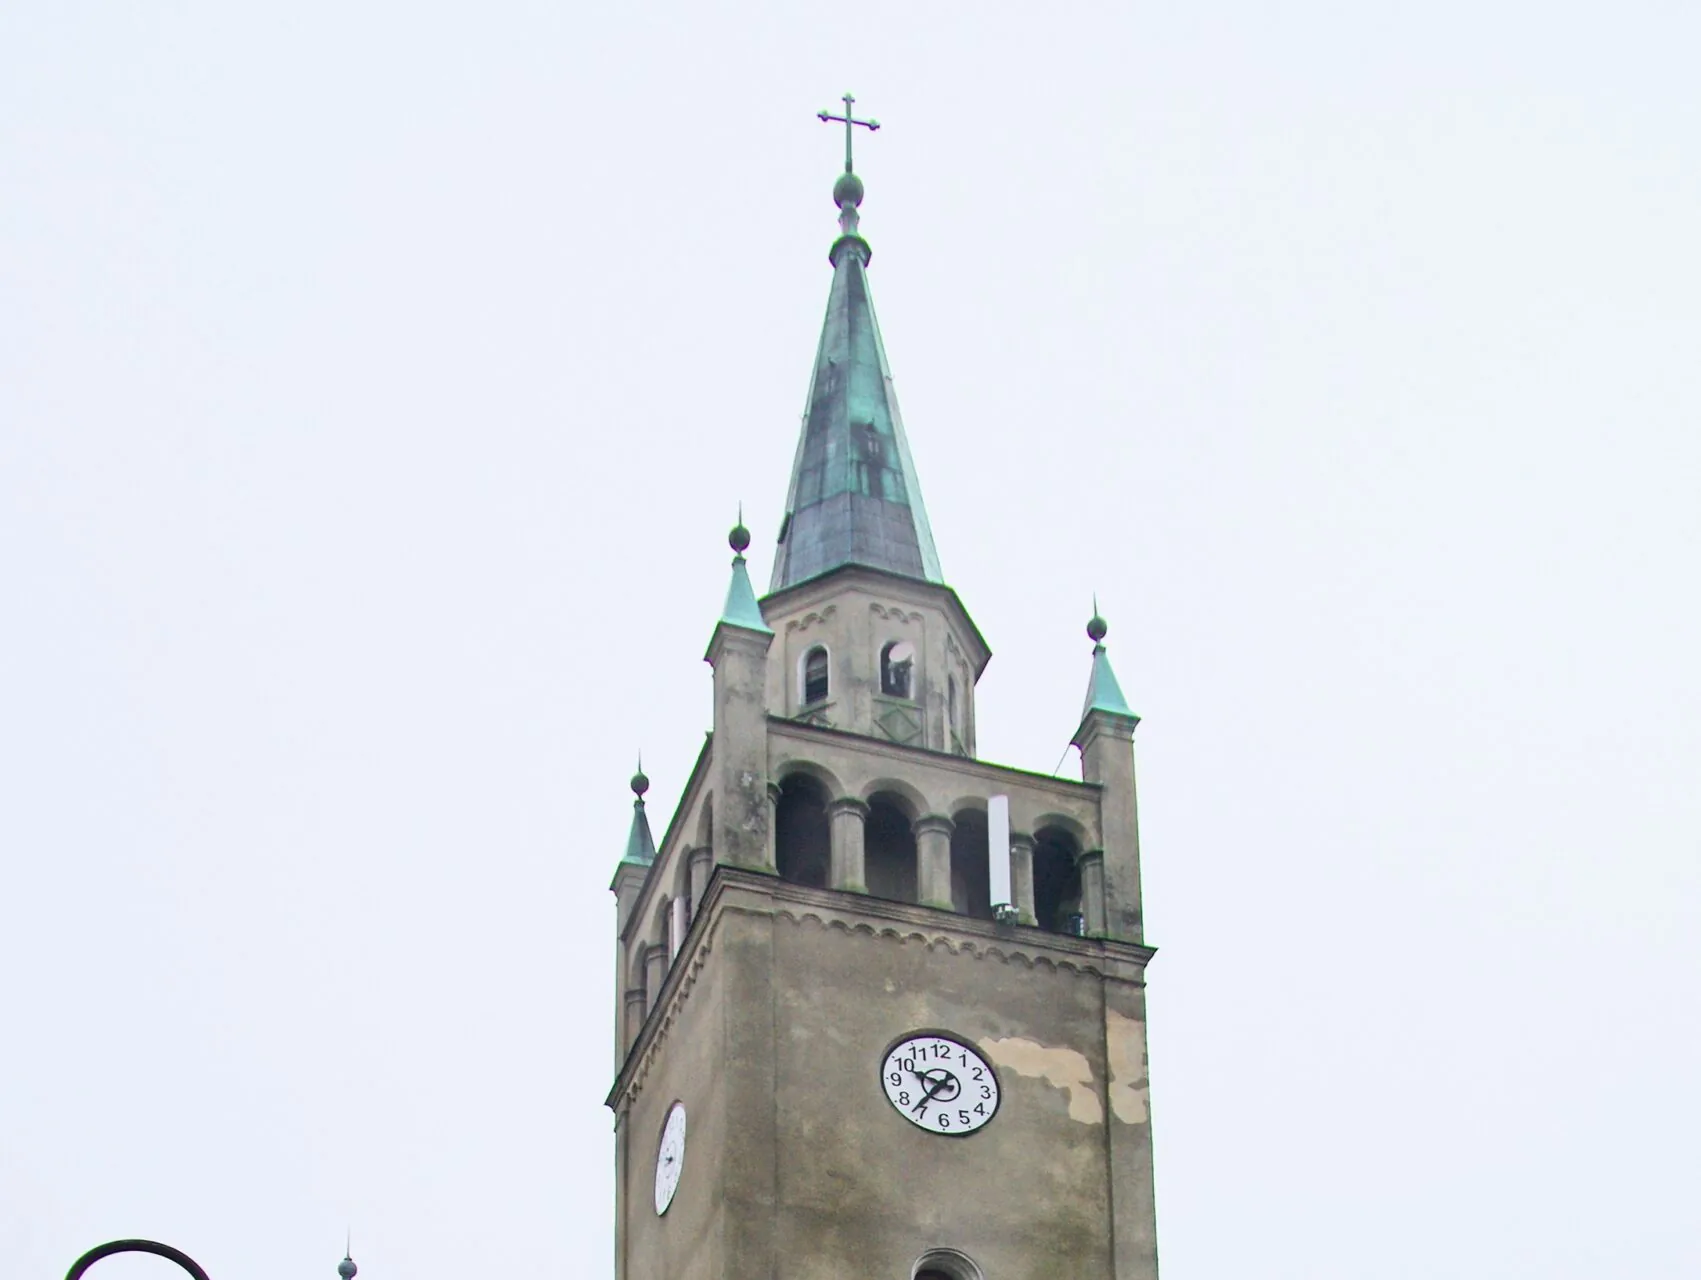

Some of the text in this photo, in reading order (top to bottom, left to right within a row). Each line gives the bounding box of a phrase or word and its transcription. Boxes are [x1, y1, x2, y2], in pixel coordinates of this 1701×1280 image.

[908, 1046, 926, 1061] 11
[930, 1044, 951, 1059] 12
[894, 1057, 914, 1072] 10
[958, 1053, 967, 1068] 1
[890, 1073, 902, 1086] 9
[972, 1067, 983, 1081] 2
[899, 1091, 910, 1105] 8
[980, 1085, 991, 1099] 3
[917, 1105, 928, 1119] 7
[973, 1102, 985, 1116] 4
[938, 1113, 950, 1127] 6
[958, 1110, 970, 1124] 5
